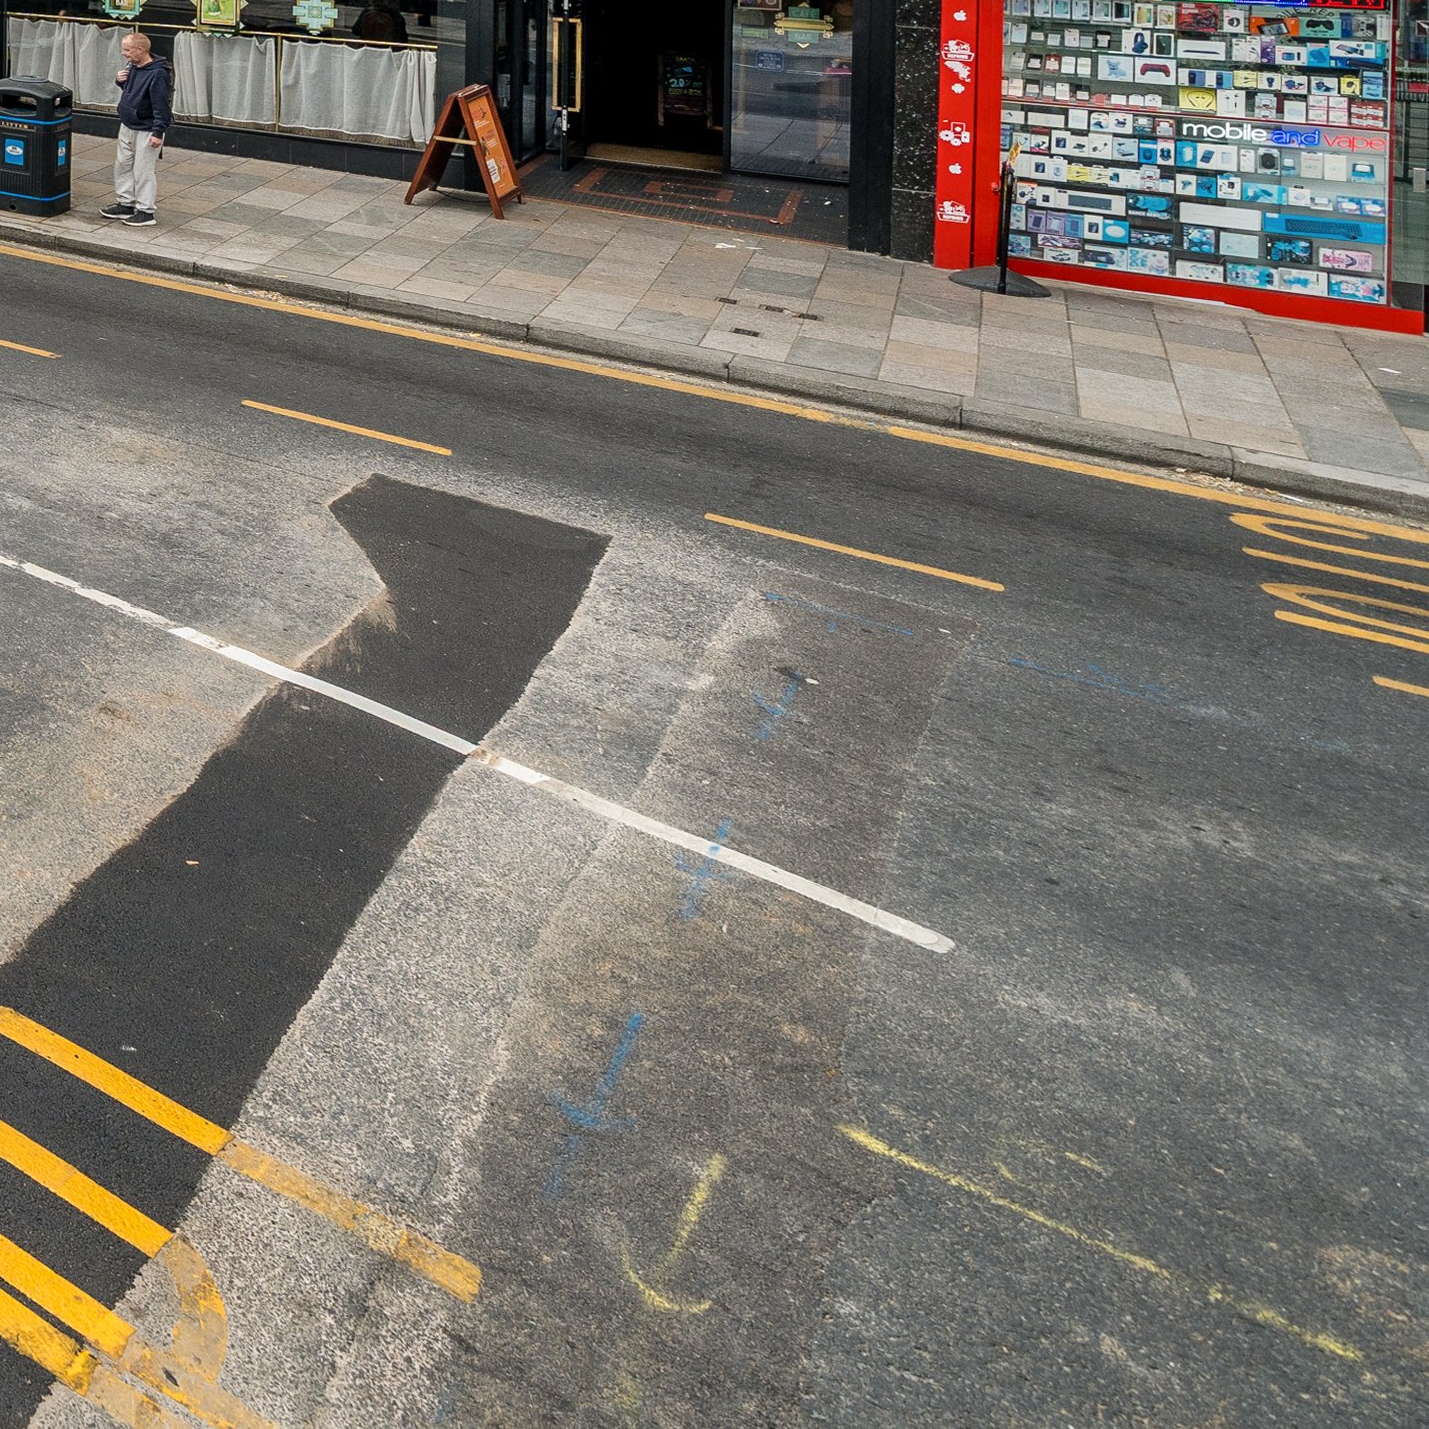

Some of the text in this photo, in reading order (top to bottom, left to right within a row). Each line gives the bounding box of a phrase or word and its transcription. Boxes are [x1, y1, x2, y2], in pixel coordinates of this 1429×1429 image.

[1, 121, 29, 129] LITTER
[1181, 121, 1387, 152] mobile and vape
